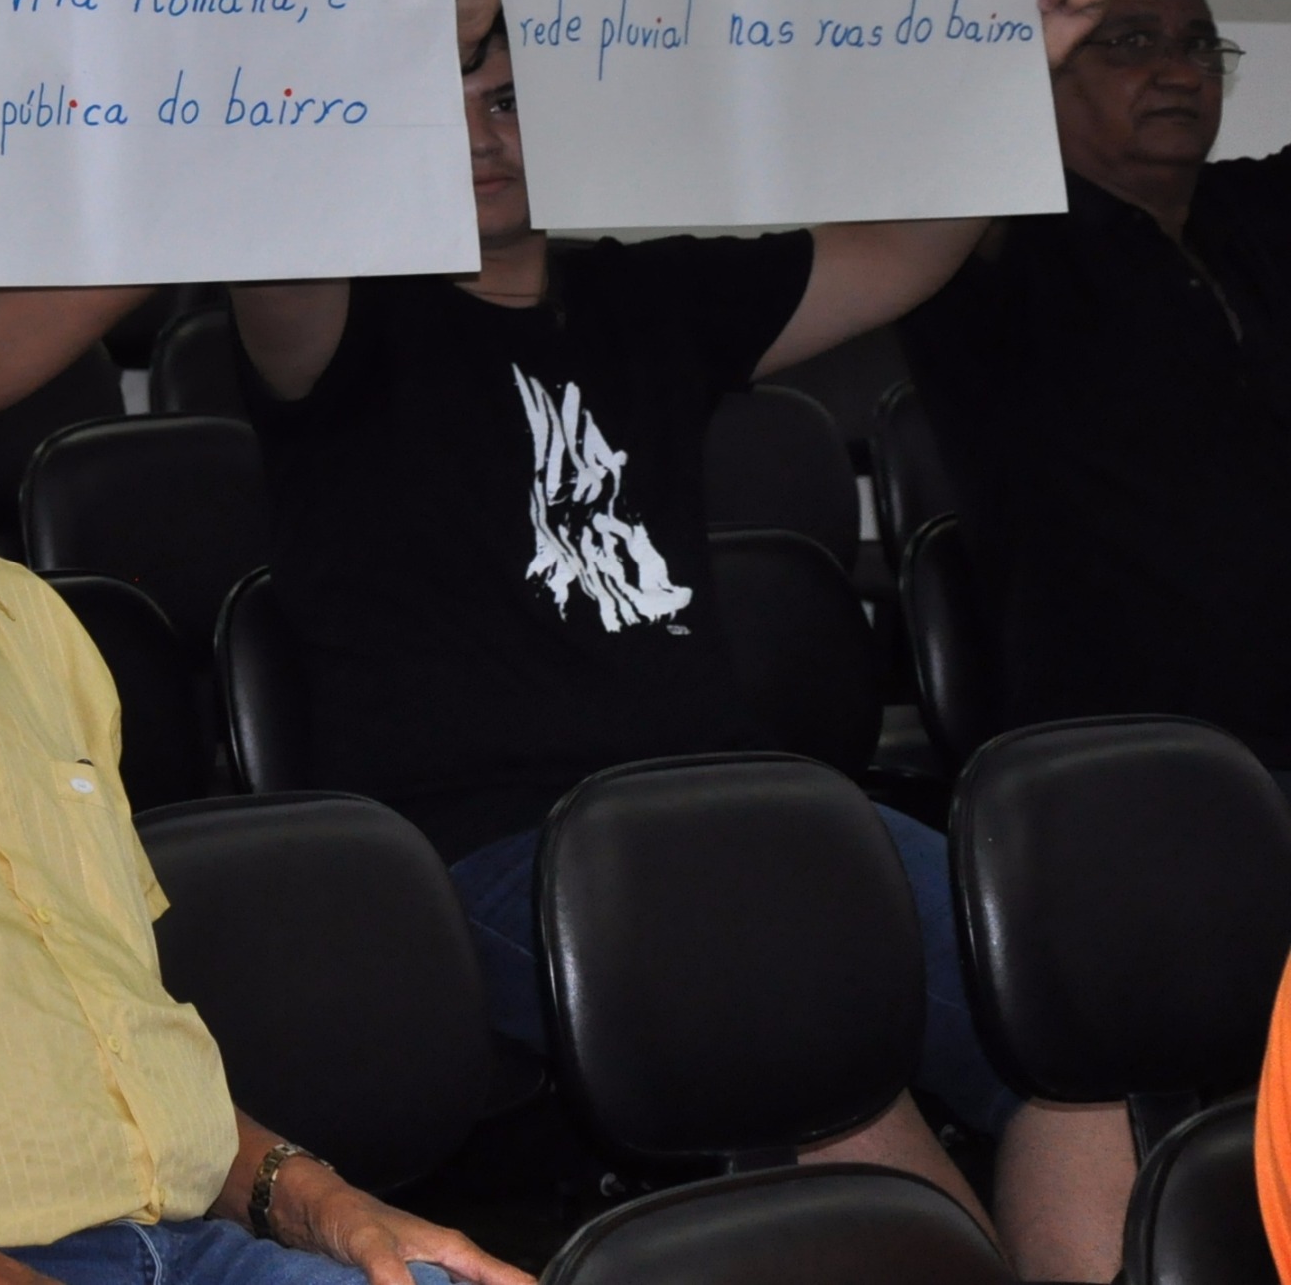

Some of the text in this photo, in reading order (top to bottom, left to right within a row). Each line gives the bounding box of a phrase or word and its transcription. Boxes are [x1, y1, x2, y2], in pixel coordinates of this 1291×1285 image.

[730, 14, 794, 47] nas
[815, 20, 882, 48] ruas
[1, 82, 128, 155] pública
[158, 70, 199, 125] do
[225, 66, 368, 127] bairro
